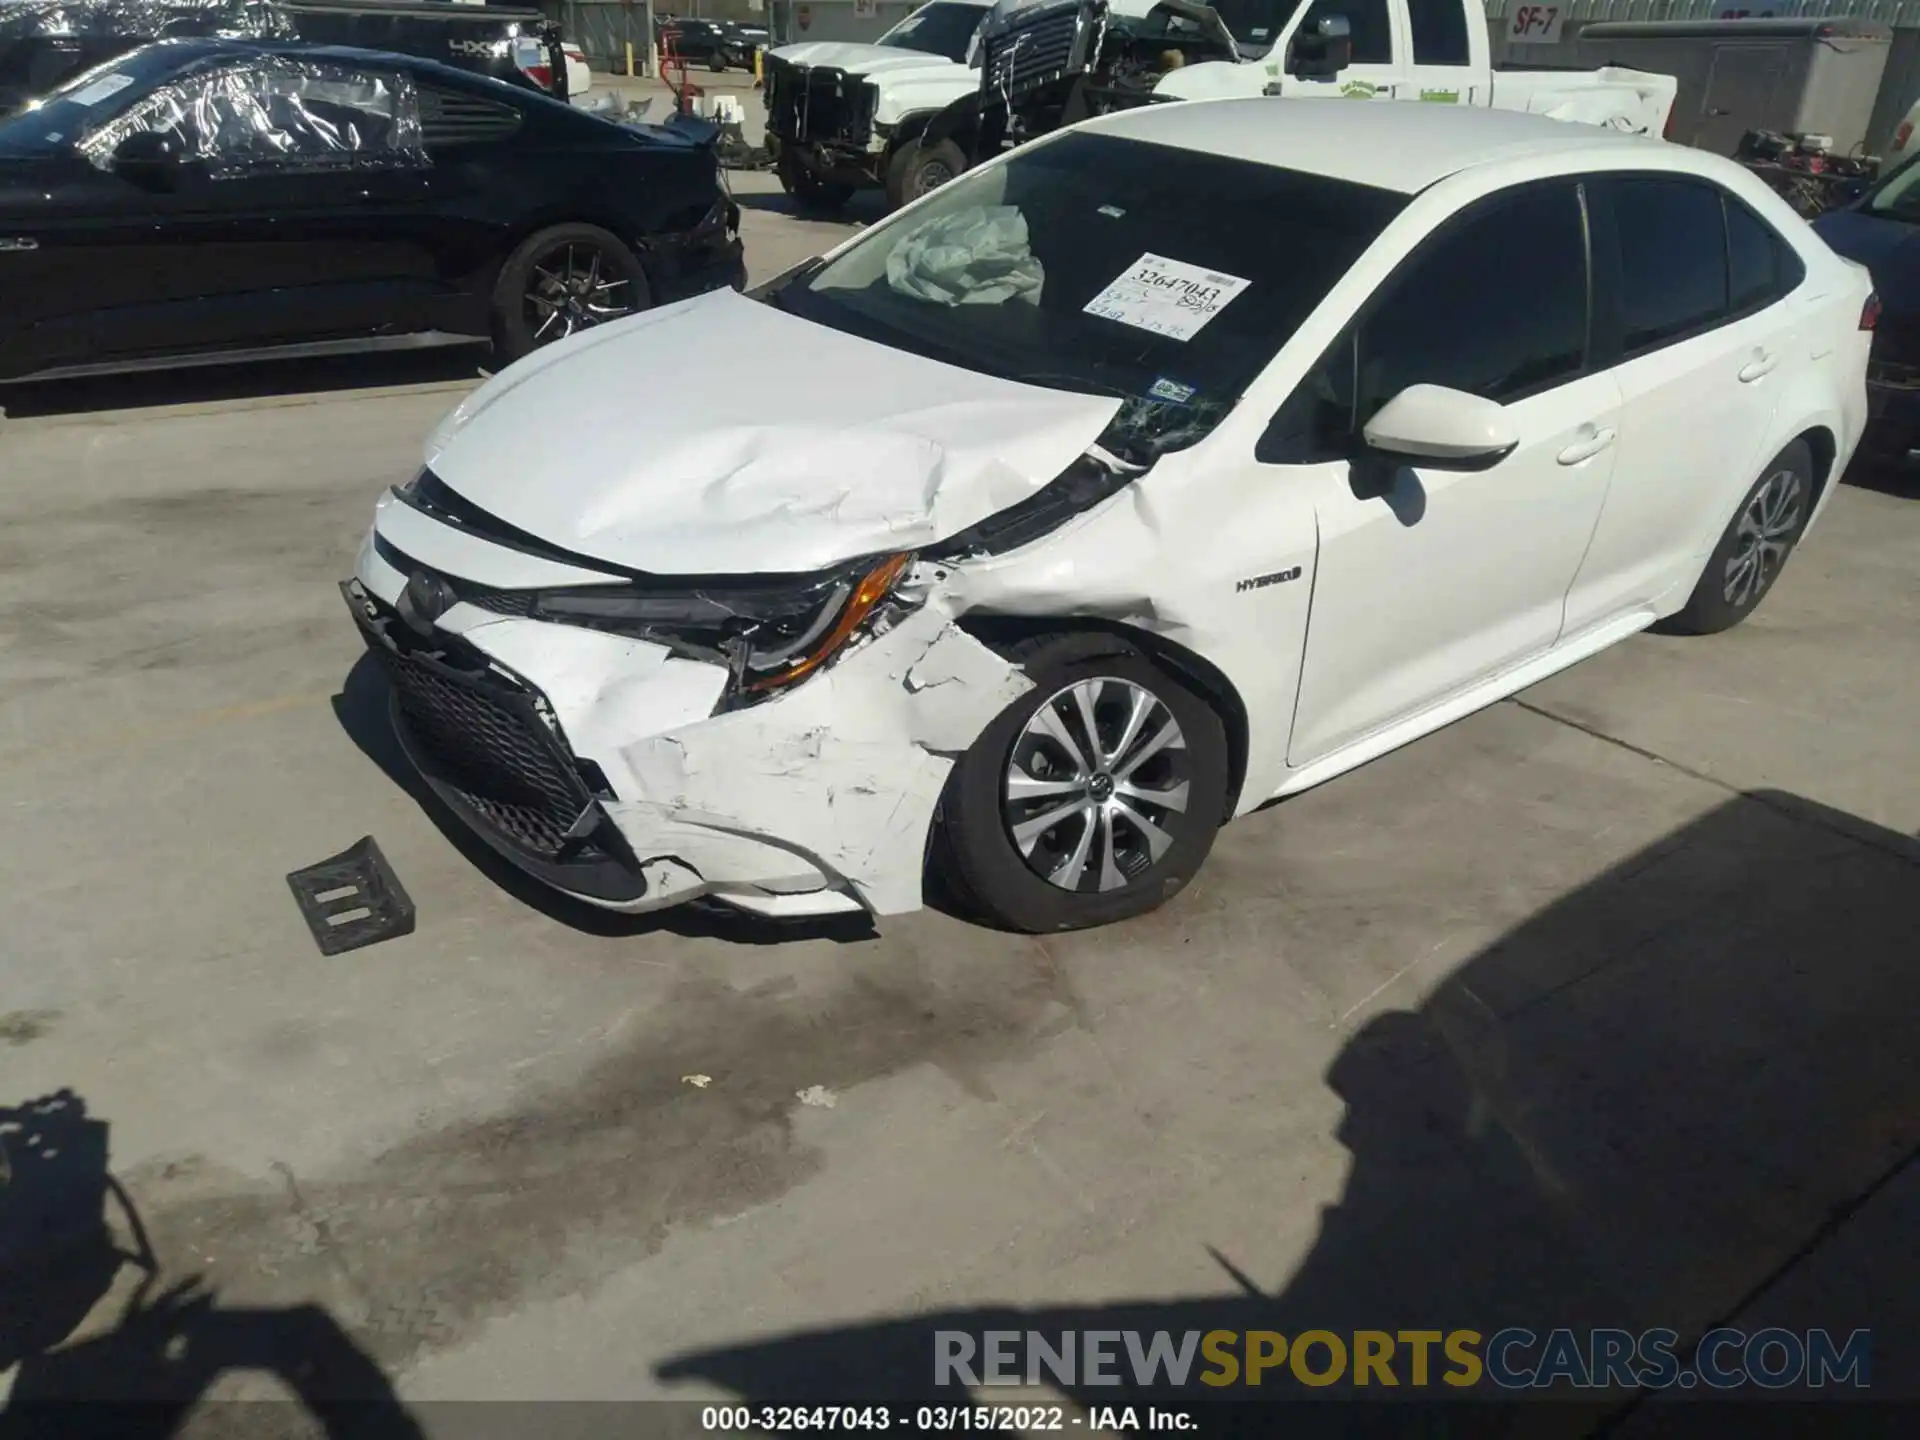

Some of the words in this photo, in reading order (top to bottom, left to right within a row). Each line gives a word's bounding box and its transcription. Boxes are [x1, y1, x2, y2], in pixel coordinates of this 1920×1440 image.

[1513, 6, 1558, 35] SF-7
[1131, 268, 1221, 300] 32647043
[1236, 569, 1293, 593] HYBRID
